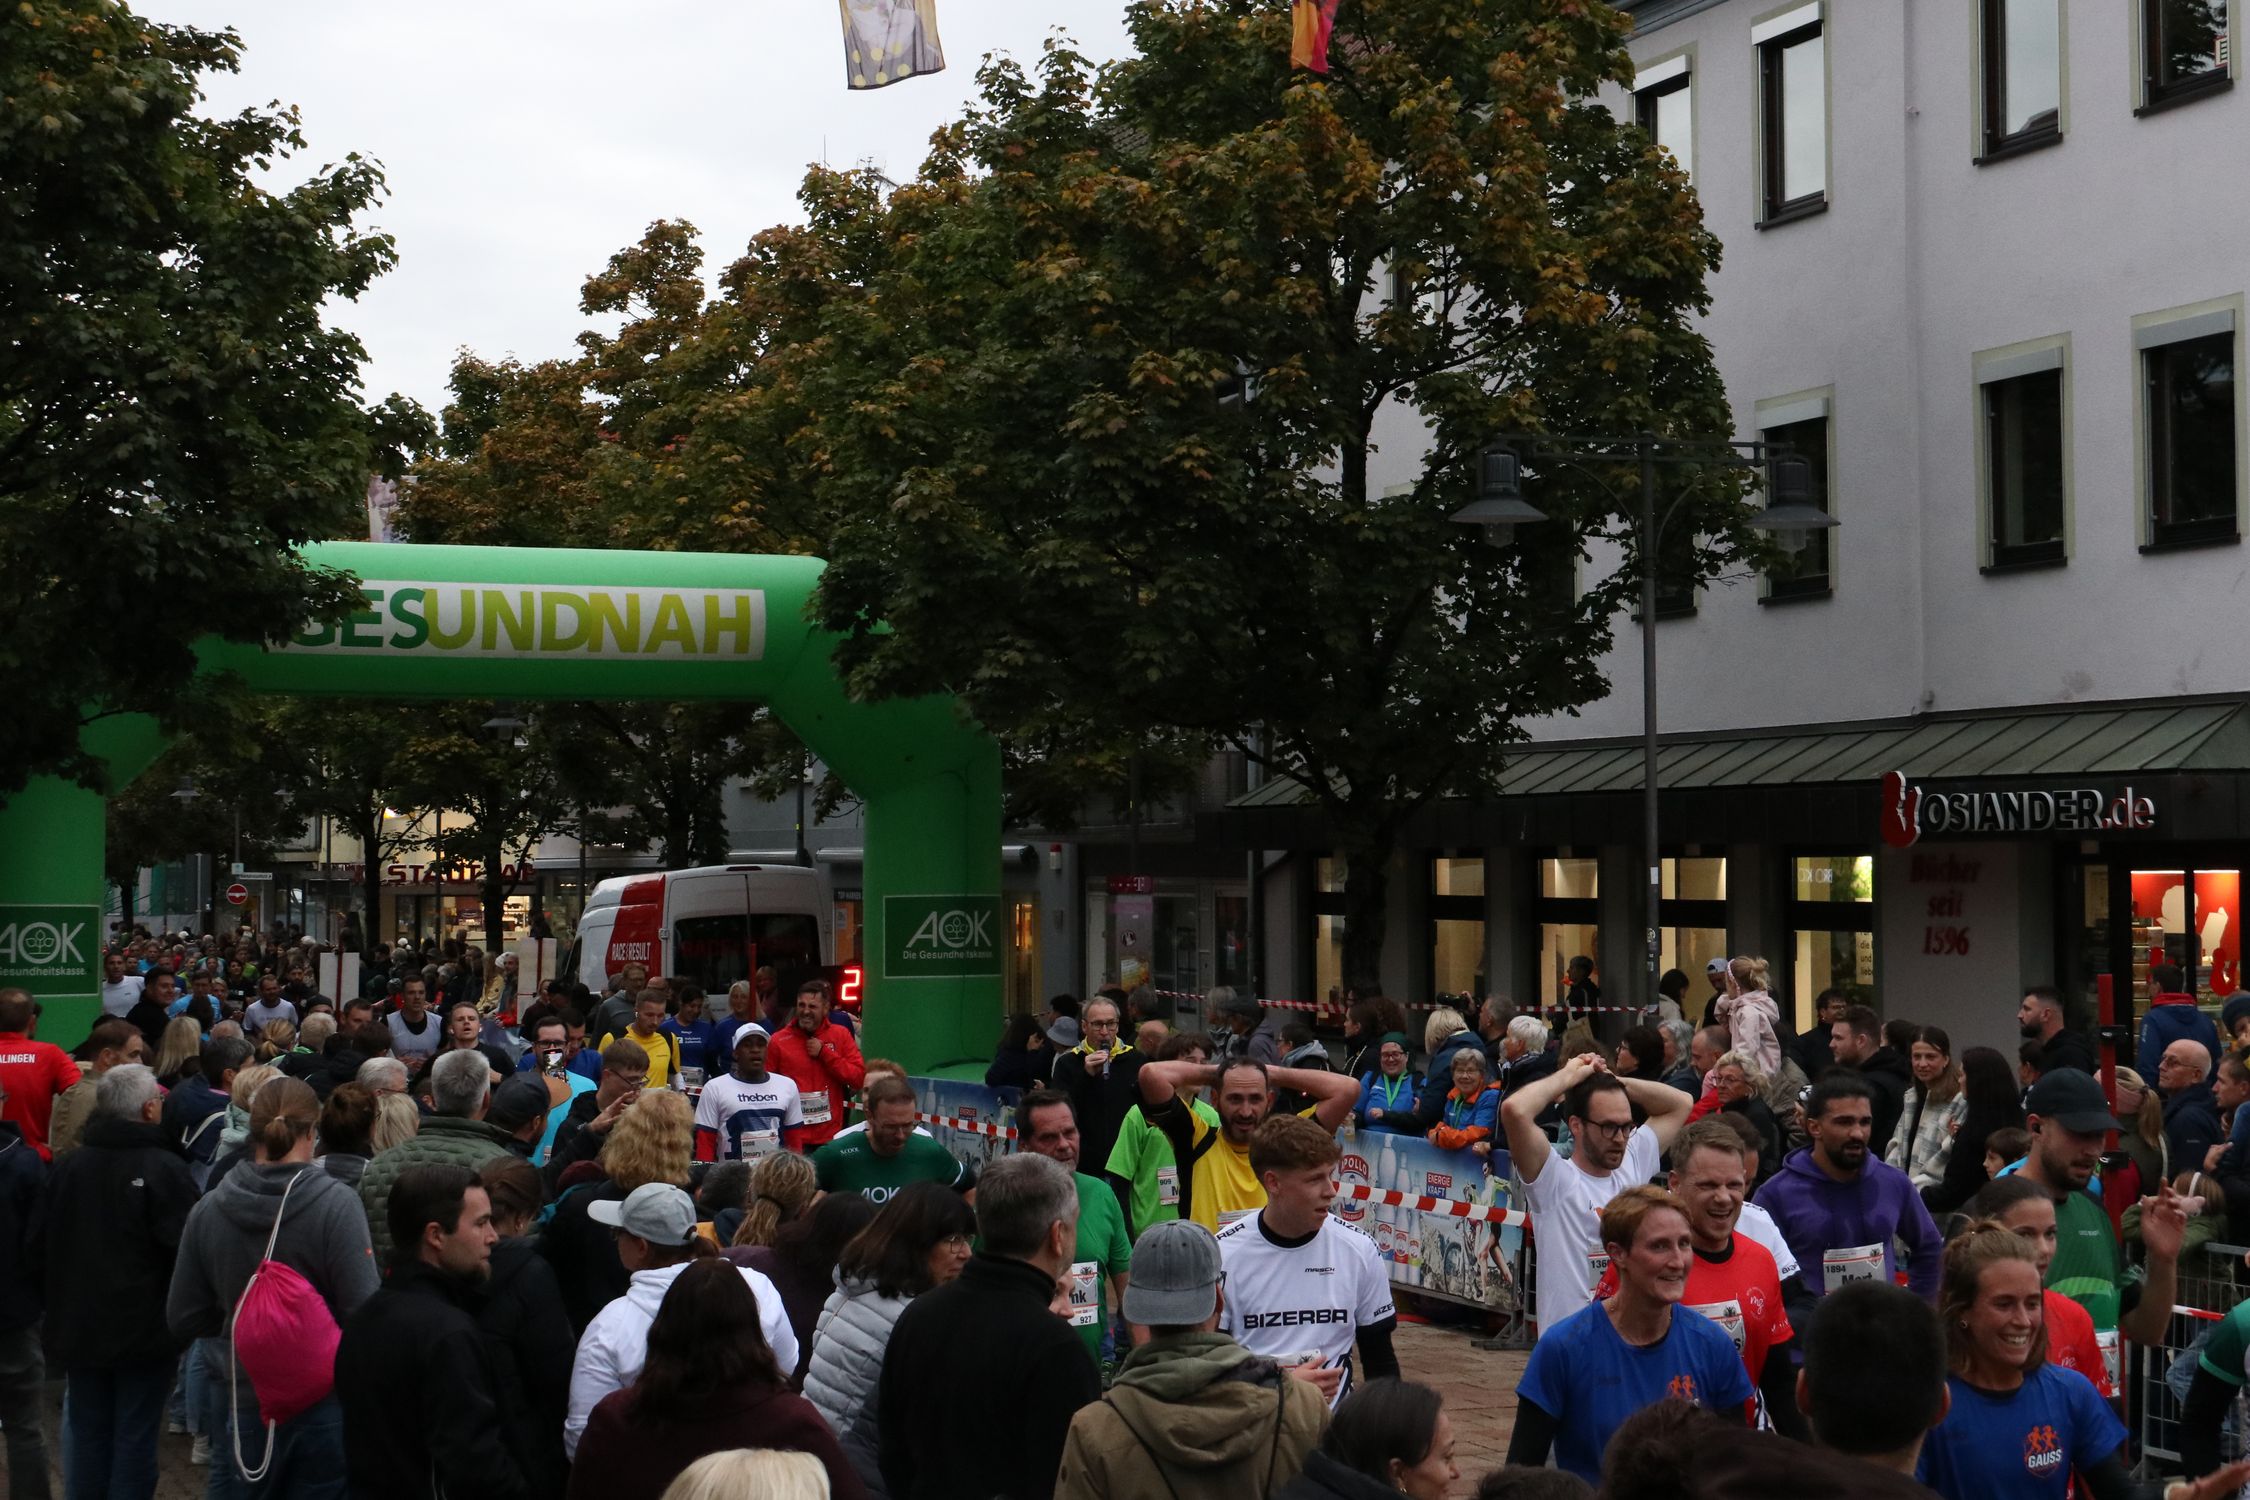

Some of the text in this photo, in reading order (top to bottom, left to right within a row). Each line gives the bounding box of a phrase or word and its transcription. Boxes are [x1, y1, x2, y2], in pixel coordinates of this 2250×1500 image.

[906, 910, 992, 948] AOK
[0, 922, 86, 964] AOK
[1923, 926, 1971, 955] 1596
[903, 951, 917, 959] Die
[841, 969, 861, 1001] 2
[737, 1093, 778, 1102] theben
[1591, 1260, 1609, 1269] 136
[1080, 1315, 1092, 1323] 927
[1243, 1309, 1348, 1330] BIZERBA
[2028, 1448, 2063, 1468] GAUSS
